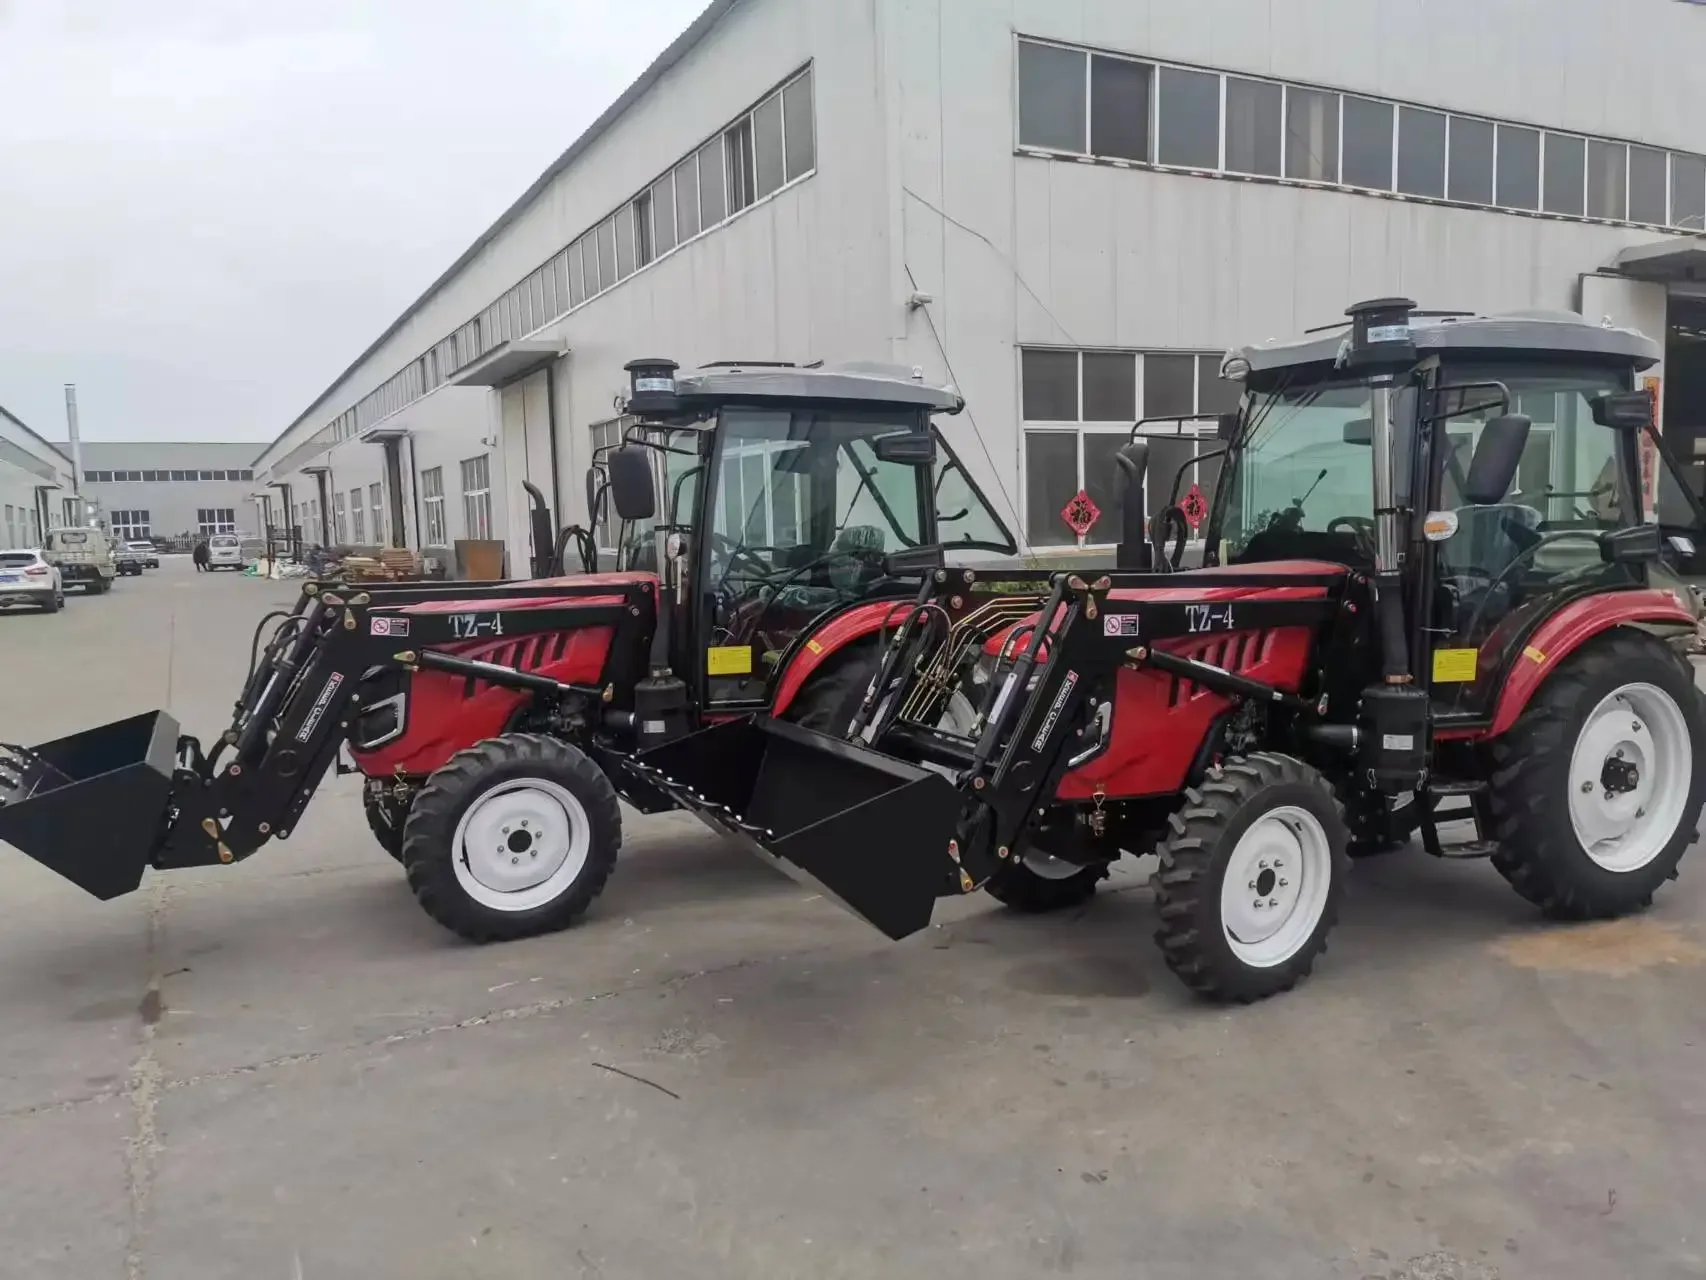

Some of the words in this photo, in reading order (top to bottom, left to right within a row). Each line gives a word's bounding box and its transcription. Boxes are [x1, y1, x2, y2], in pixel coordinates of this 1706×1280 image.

[448, 611, 504, 639] TZ-4
[1185, 603, 1235, 633] TZ-4
[318, 680, 338, 706] KEEP
[1054, 679, 1073, 709] KEEP
[299, 707, 323, 740] CLEAR
[1034, 711, 1057, 750] CLEAR
